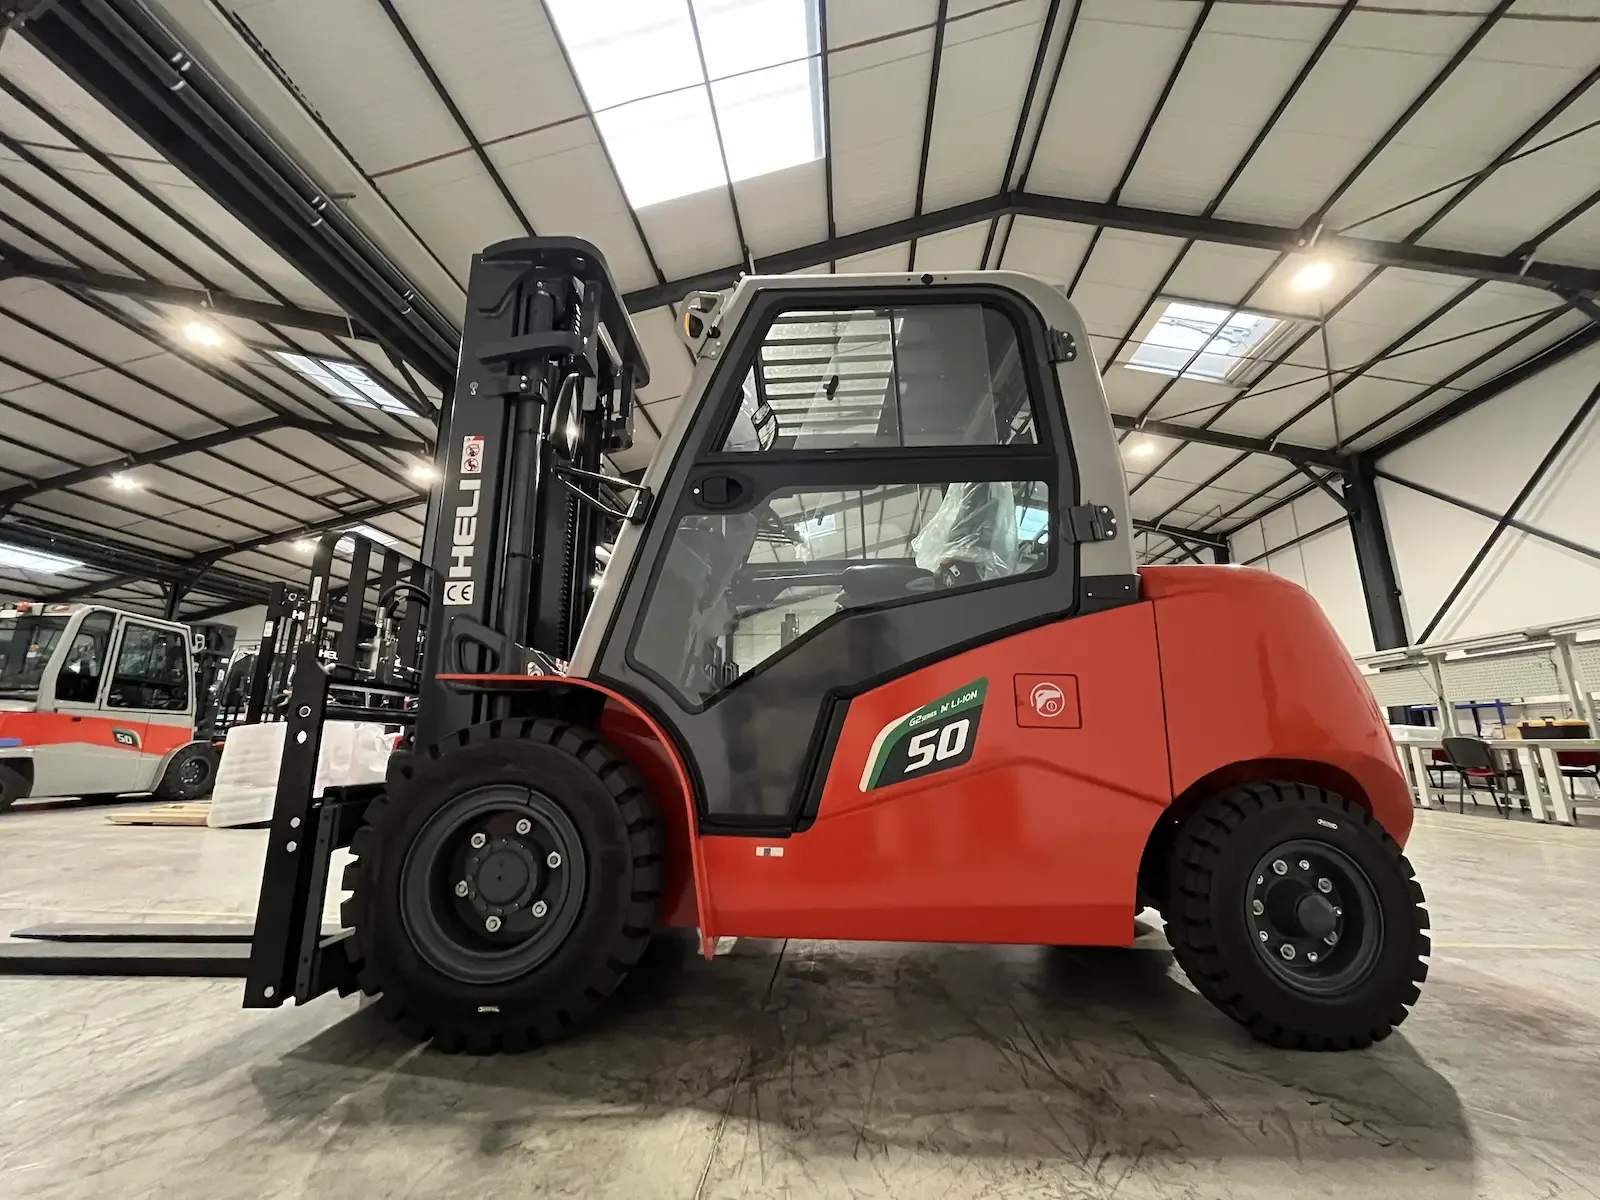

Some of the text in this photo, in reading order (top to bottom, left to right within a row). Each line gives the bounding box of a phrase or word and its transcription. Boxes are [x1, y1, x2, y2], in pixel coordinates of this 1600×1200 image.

[448, 479, 482, 578] HELI
[950, 689, 978, 709] LI-ION
[116, 733, 133, 745] 50
[903, 718, 970, 774] 50
